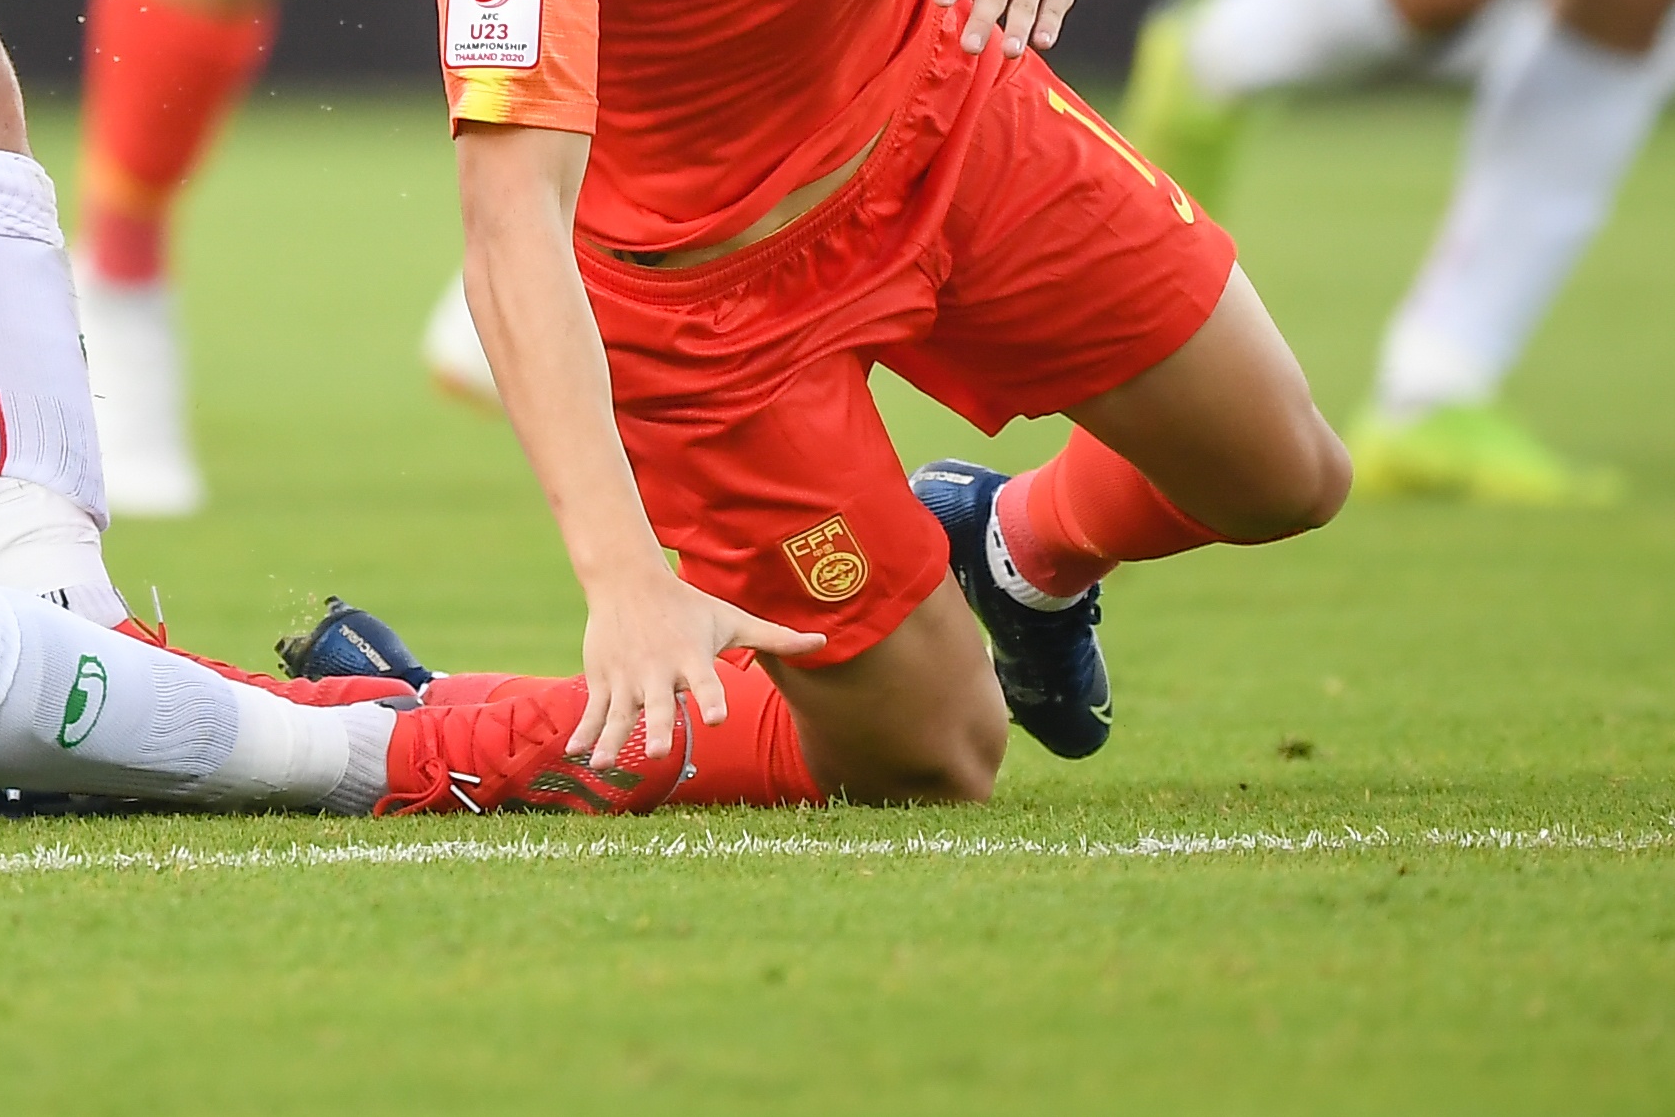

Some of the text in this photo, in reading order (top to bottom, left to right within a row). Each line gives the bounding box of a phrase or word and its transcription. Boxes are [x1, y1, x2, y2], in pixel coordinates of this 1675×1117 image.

[481, 13, 500, 21] AFC
[470, 23, 509, 40] U23
[454, 42, 528, 51] CHAMPIONSHIP
[455, 53, 525, 62] THAILAND 2020
[790, 522, 844, 558] CFA
